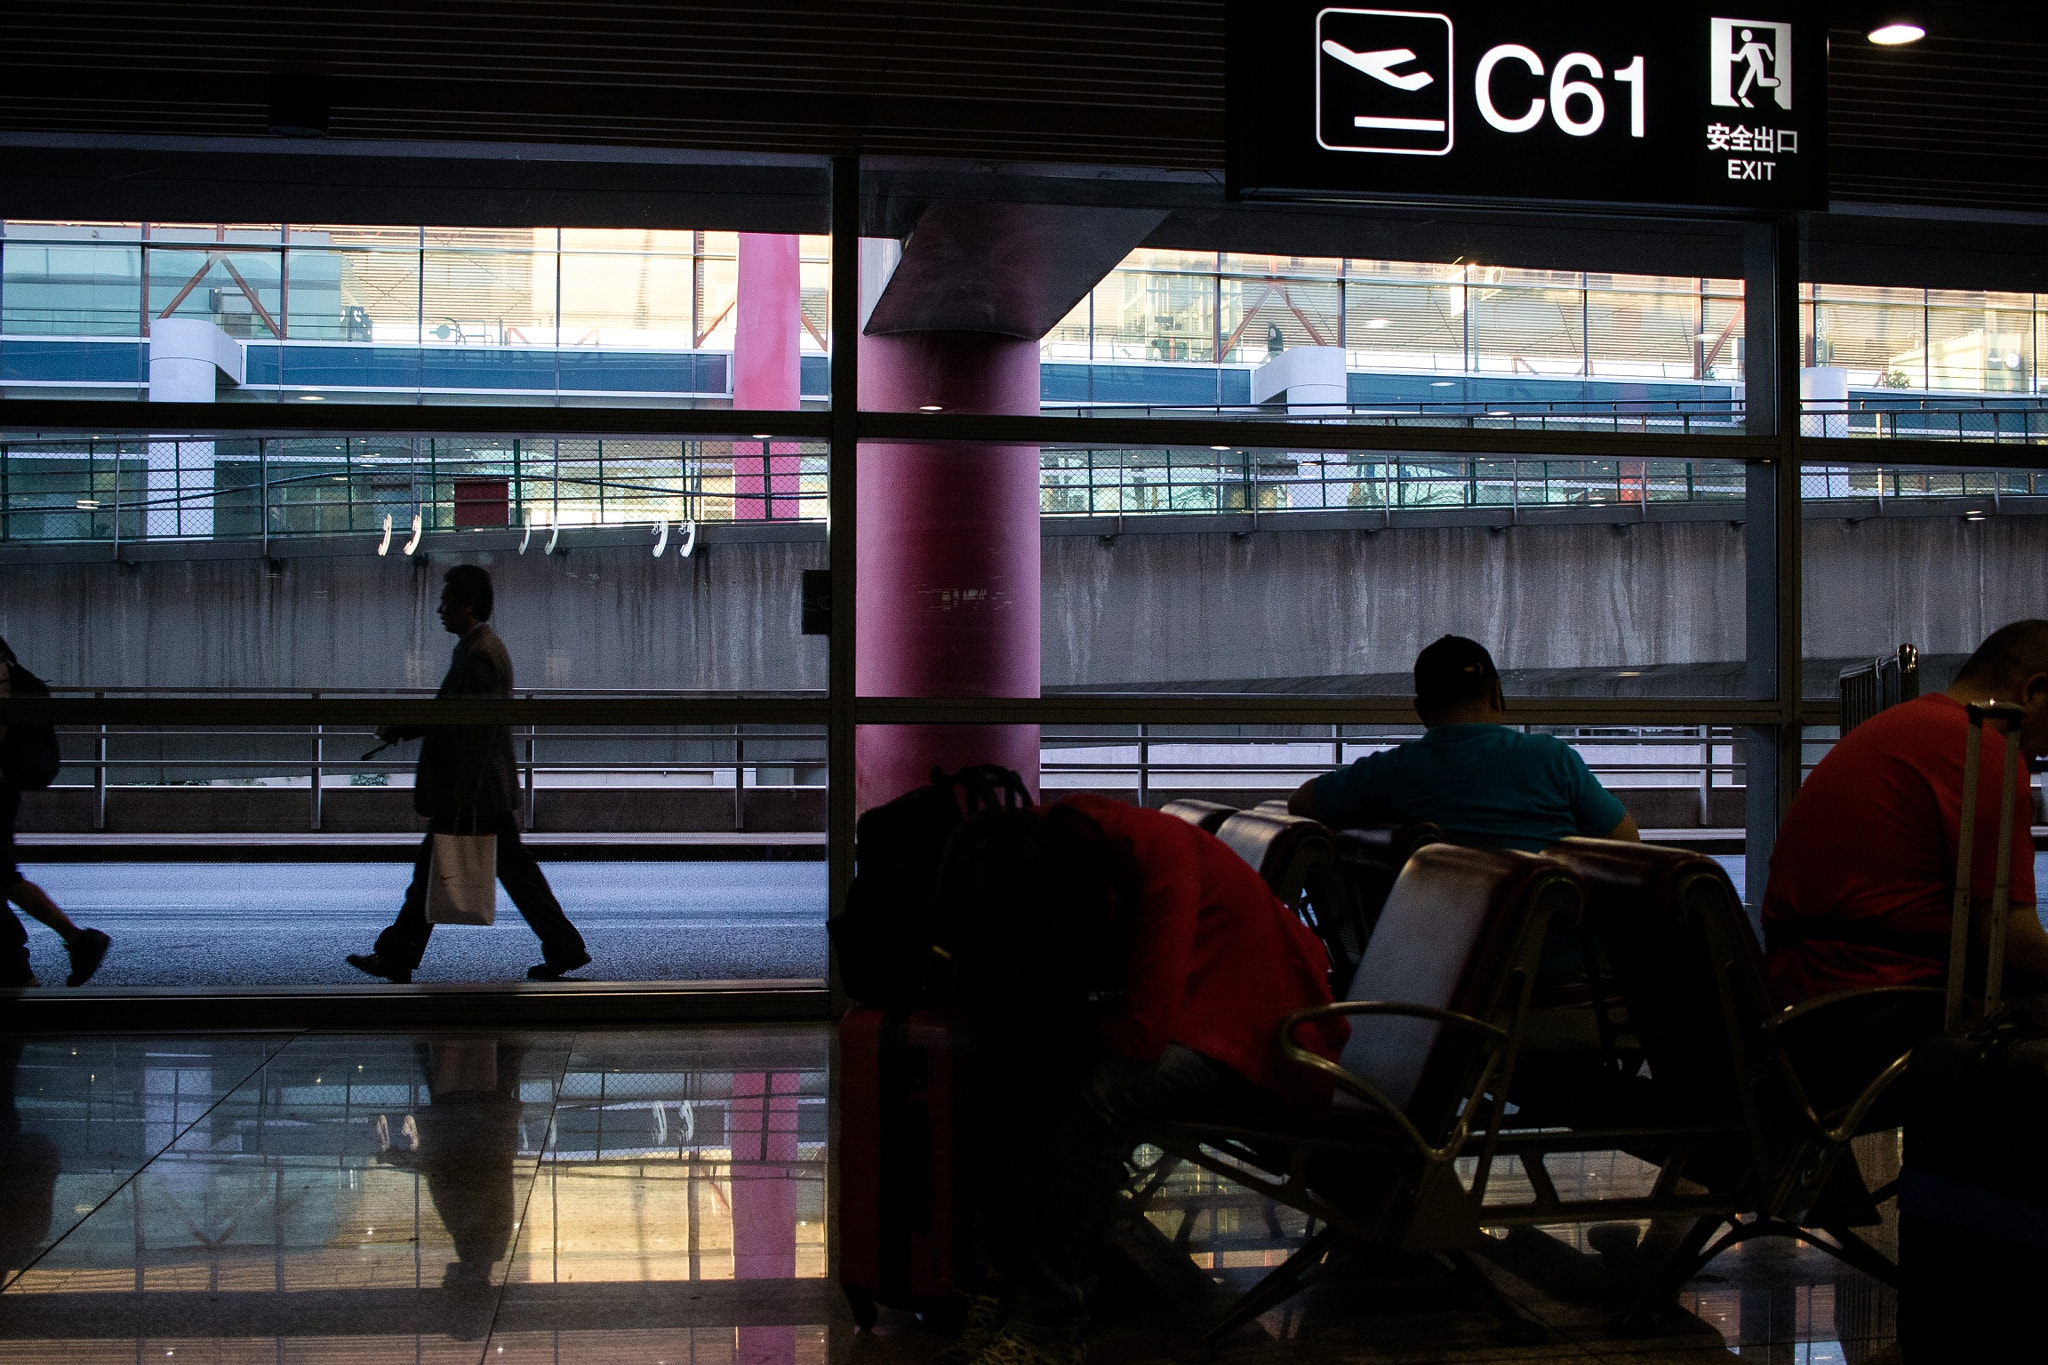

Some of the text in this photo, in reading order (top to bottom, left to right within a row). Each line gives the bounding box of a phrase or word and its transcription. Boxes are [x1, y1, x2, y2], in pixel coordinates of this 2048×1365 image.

[1475, 44, 1644, 137] C61
[1706, 122, 1798, 154] 安全出口
[1727, 158, 1776, 181] EXIT
